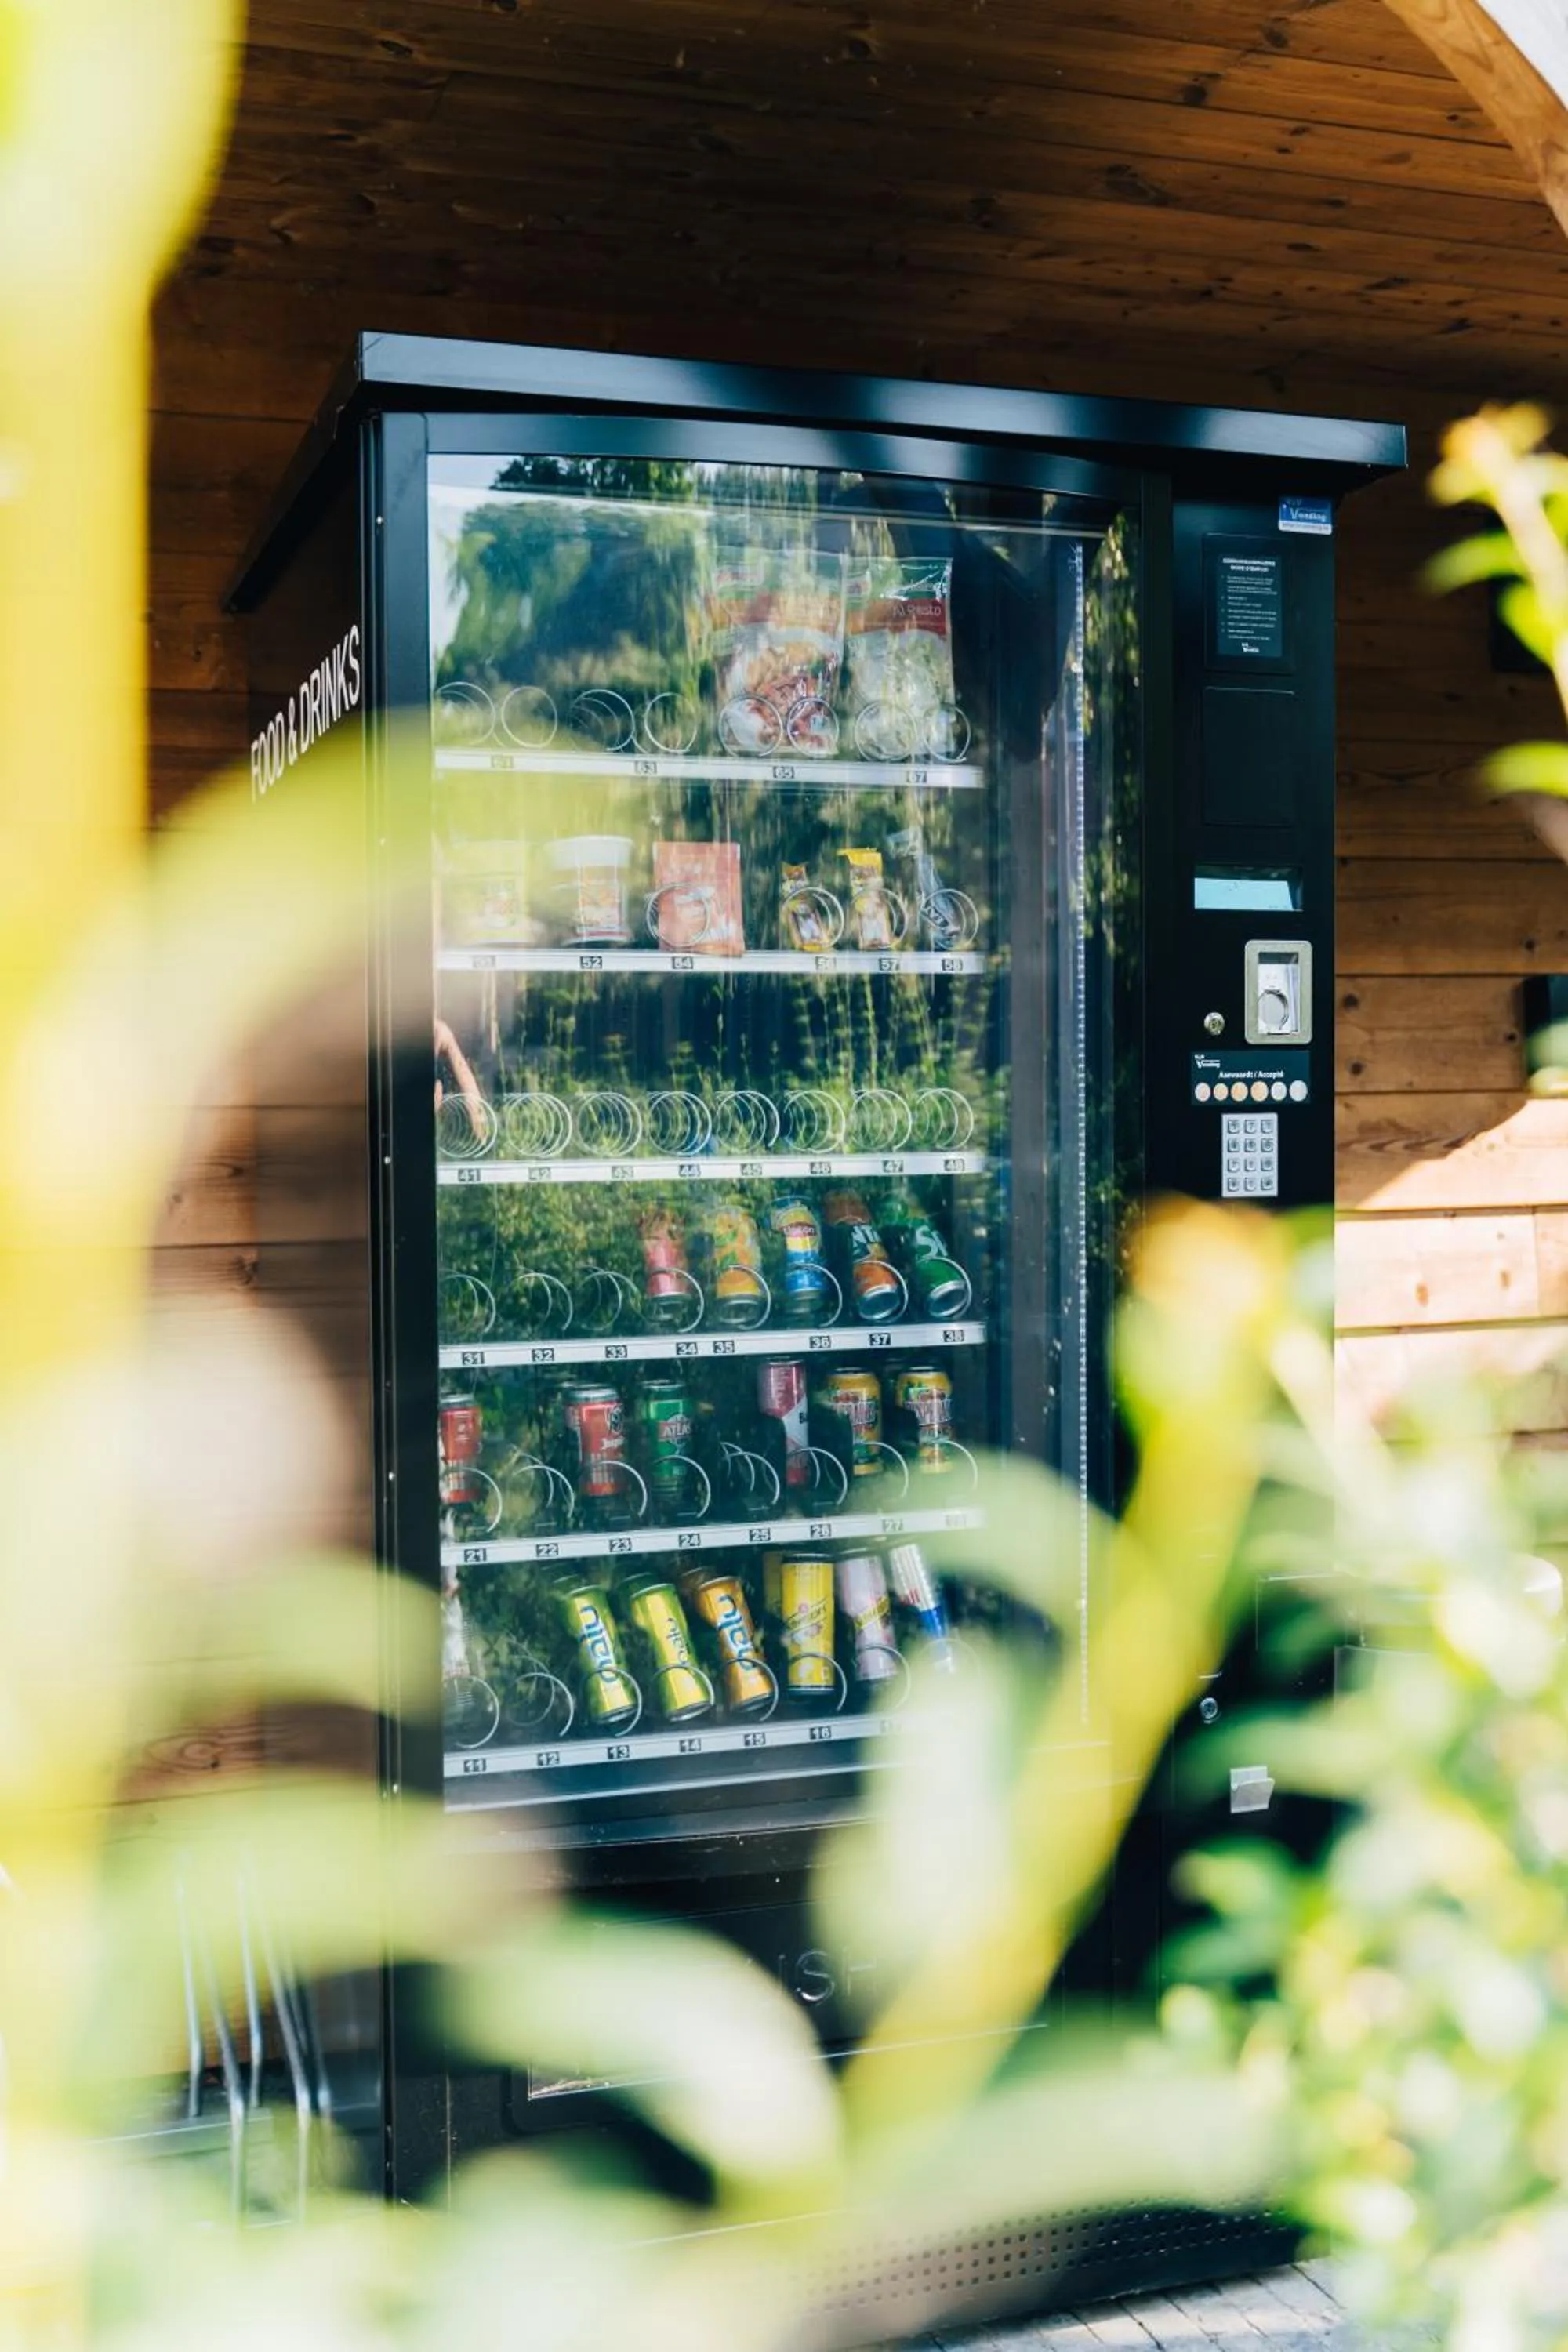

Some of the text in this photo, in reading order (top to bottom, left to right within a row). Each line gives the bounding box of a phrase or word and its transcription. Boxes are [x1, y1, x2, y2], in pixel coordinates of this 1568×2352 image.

[251, 625, 361, 804] FOOD & DRINKS
[581, 956, 601, 968] 52
[880, 958, 898, 970] 57
[884, 1160, 902, 1172] 47
[463, 1330, 963, 1364] 31 32 33 34 35 36 37 38
[466, 1519, 902, 1561] 21 22 23 24 25 26 27
[465, 1726, 829, 1772] 11 12 13 14 15 16
